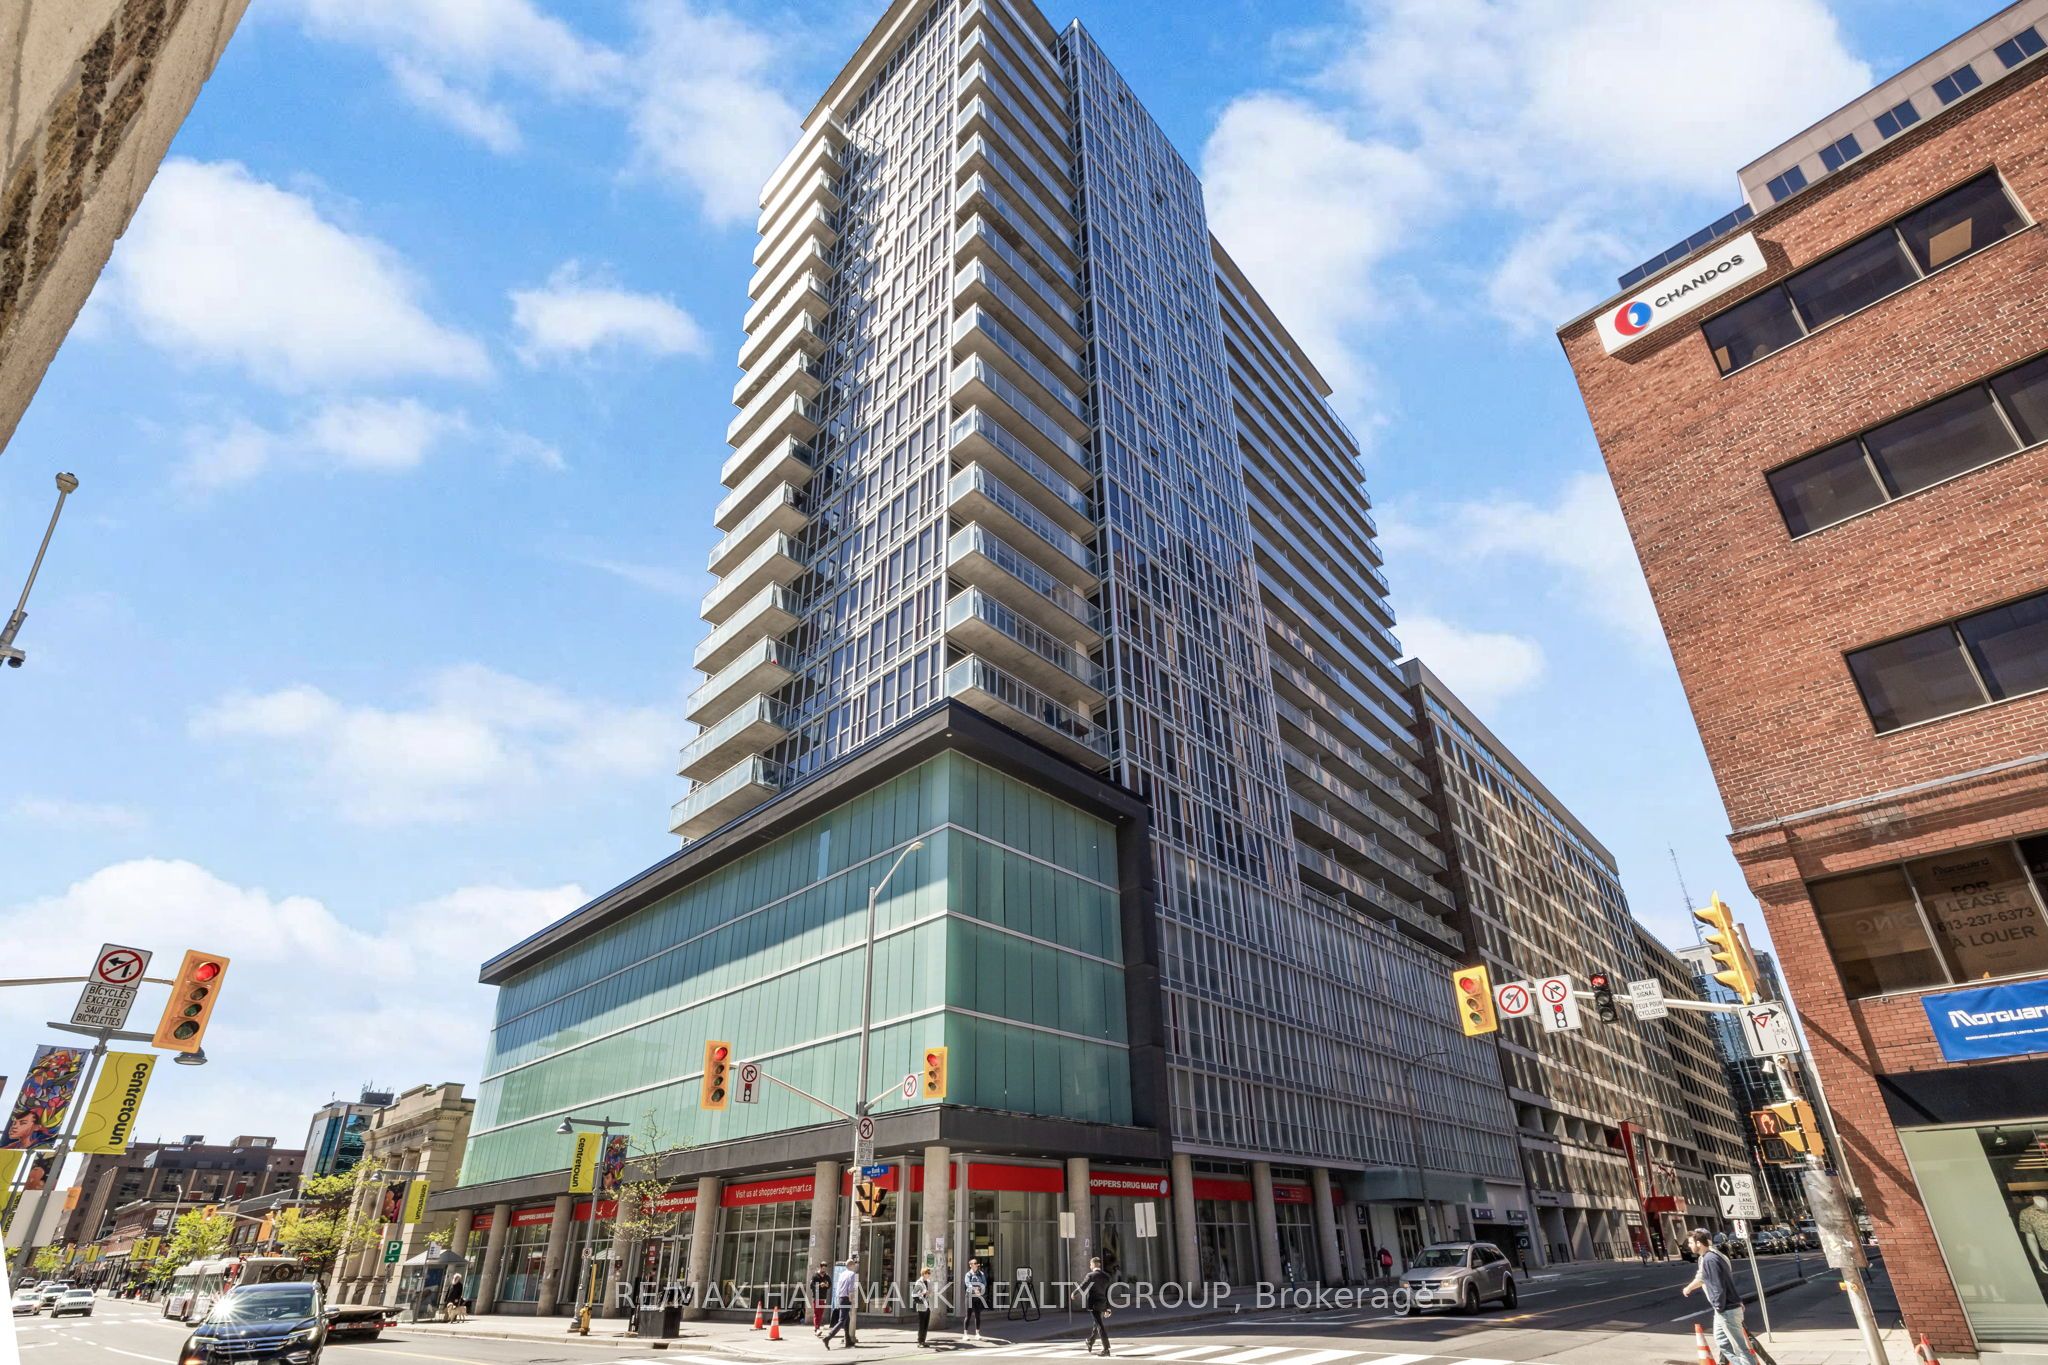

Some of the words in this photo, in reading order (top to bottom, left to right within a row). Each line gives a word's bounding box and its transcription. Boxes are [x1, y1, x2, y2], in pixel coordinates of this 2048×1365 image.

[1655, 254, 1744, 308] CHANDOS
[1951, 880, 1991, 897] FOR
[1946, 891, 2010, 912] LEASE
[1937, 906, 2036, 932] 613-237-6373
[1968, 925, 2038, 947] LOUER
[89, 986, 131, 999] BICYCLES
[1632, 983, 1656, 991] BICYCLE
[85, 995, 128, 1008] EXCEPTED
[75, 1012, 122, 1026] BICYCLETTES
[84, 1005, 104, 1015] SAUF
[105, 1007, 121, 1017] LES
[1638, 1008, 1665, 1017] CYCLISTES
[1948, 1005, 2048, 1028] Morguar
[108, 1063, 149, 1146] centretown
[572, 1137, 586, 1188] centretown
[735, 1189, 746, 1199] Visit
[752, 1189, 759, 1197] at
[758, 1184, 812, 1197] shoppersdrugmart.ca
[1089, 1179, 1121, 1188] HOPPERS
[1122, 1181, 1141, 1189] DRUG
[1141, 1182, 1159, 1190] MART
[415, 1184, 428, 1220] centretown
[389, 1241, 400, 1255] P
